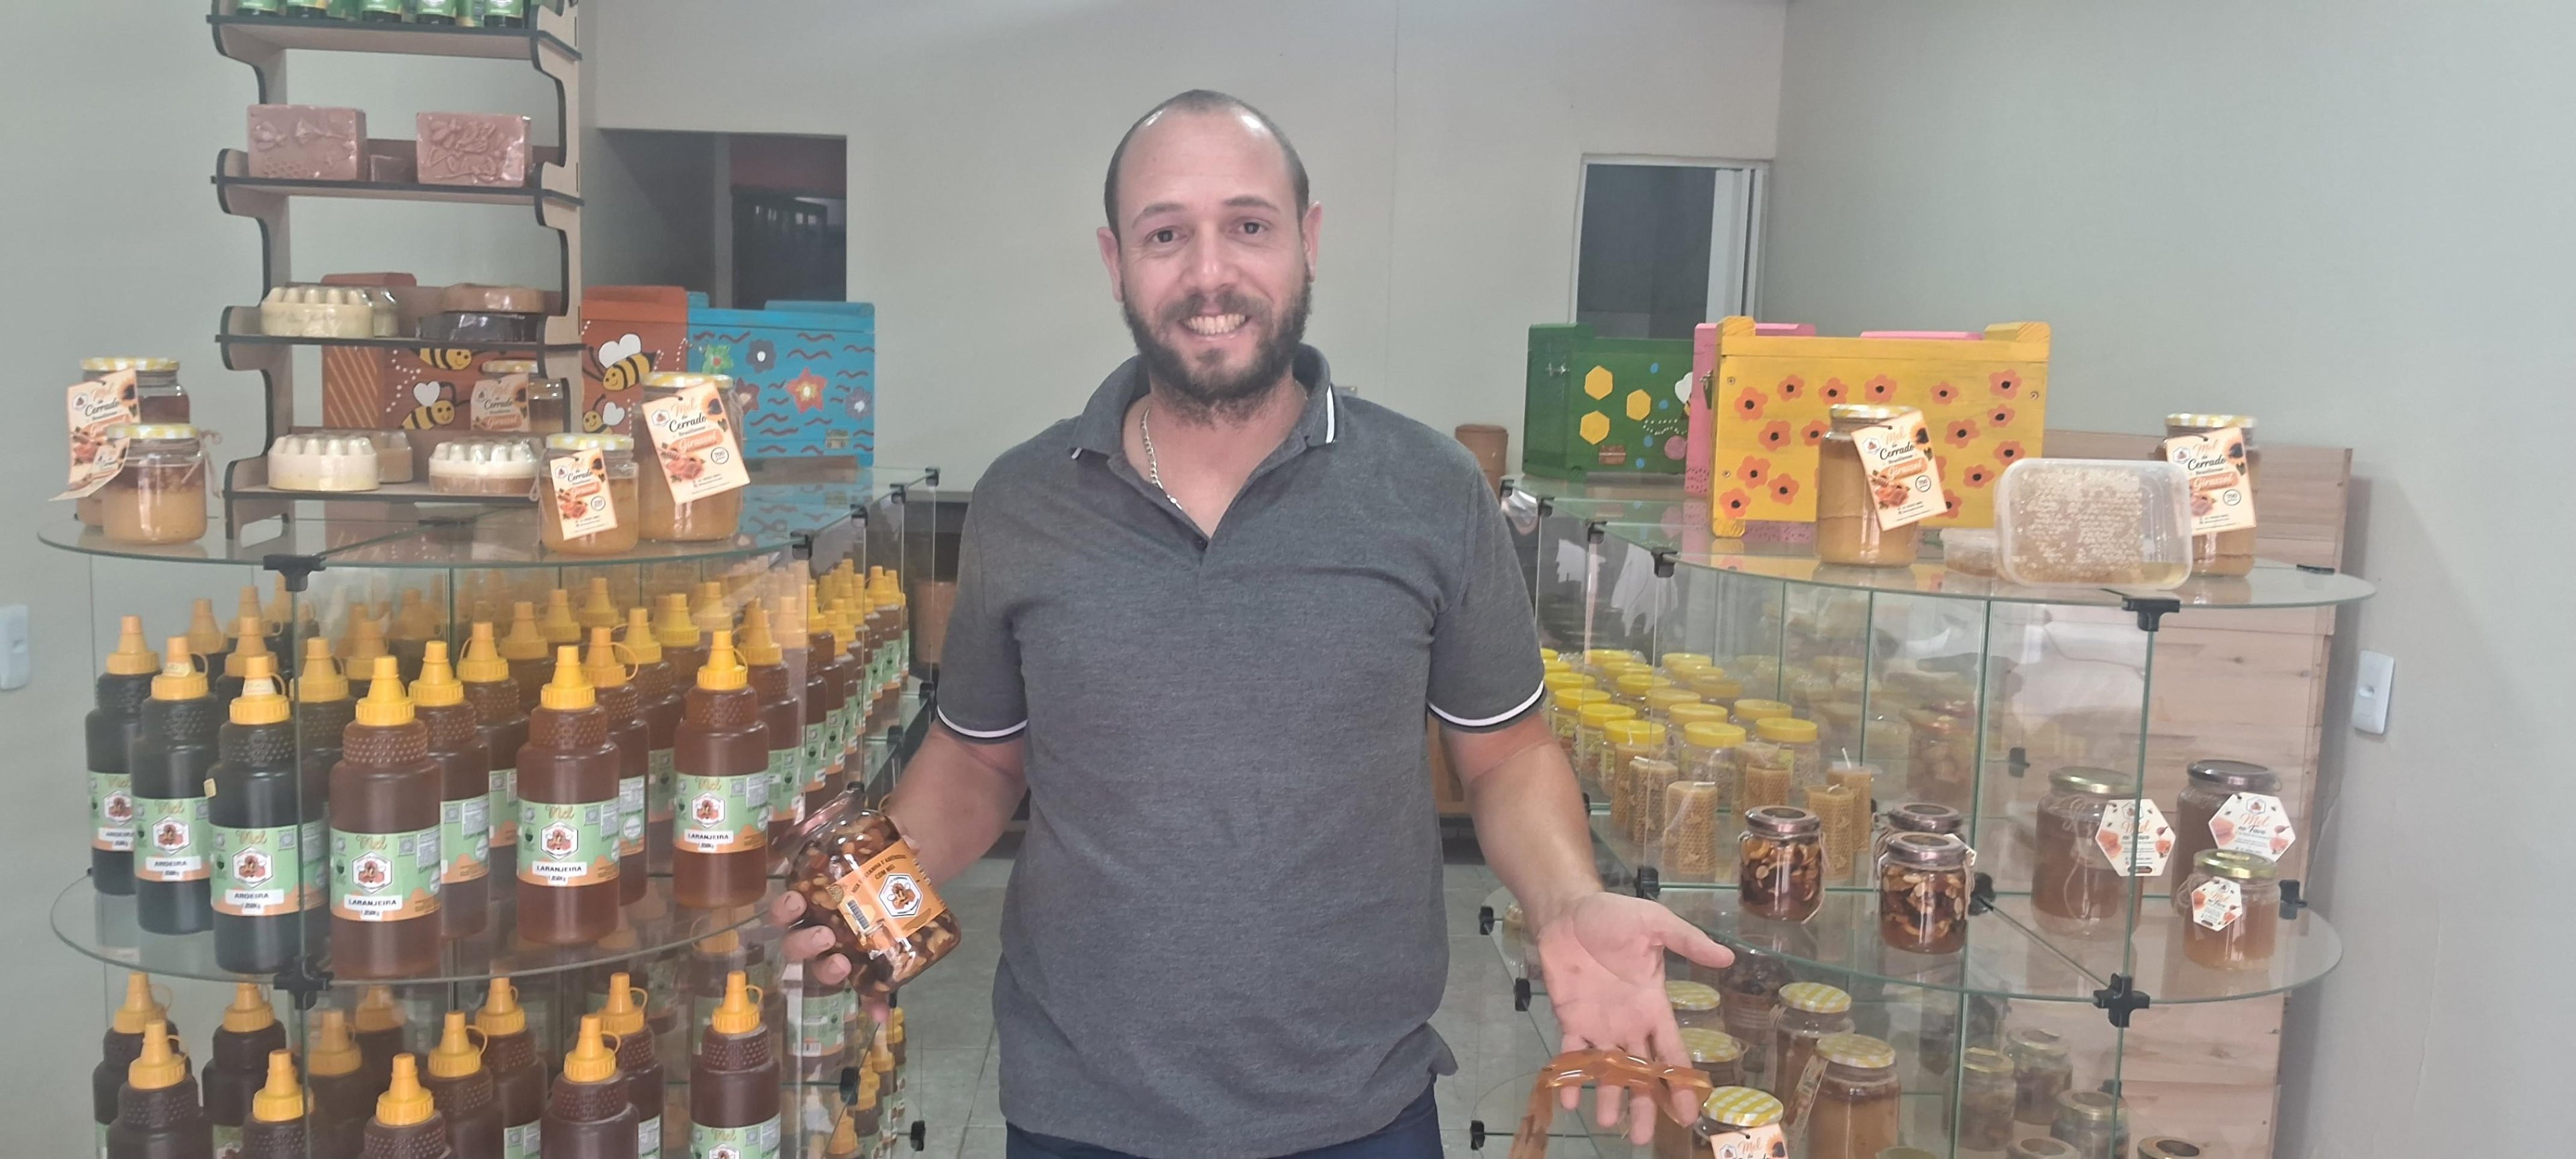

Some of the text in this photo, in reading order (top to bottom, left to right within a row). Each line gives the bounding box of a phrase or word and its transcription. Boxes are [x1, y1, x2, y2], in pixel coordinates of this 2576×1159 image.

[85, 398, 119, 417] Cerrado
[671, 397, 697, 417] Mel
[669, 412, 706, 432] Cerrado
[1882, 426, 1905, 445] Mel
[1880, 441, 1915, 460] Cerrado
[2193, 439, 2218, 455] Mel
[2188, 454, 2226, 470] Cerrado
[568, 468, 592, 482] Cerrado
[545, 805, 574, 819] Mel
[2241, 812, 2270, 826] Mel
[235, 830, 267, 844] Mel
[356, 835, 387, 850] Mel
[1737, 1137, 1762, 1154] Mel
